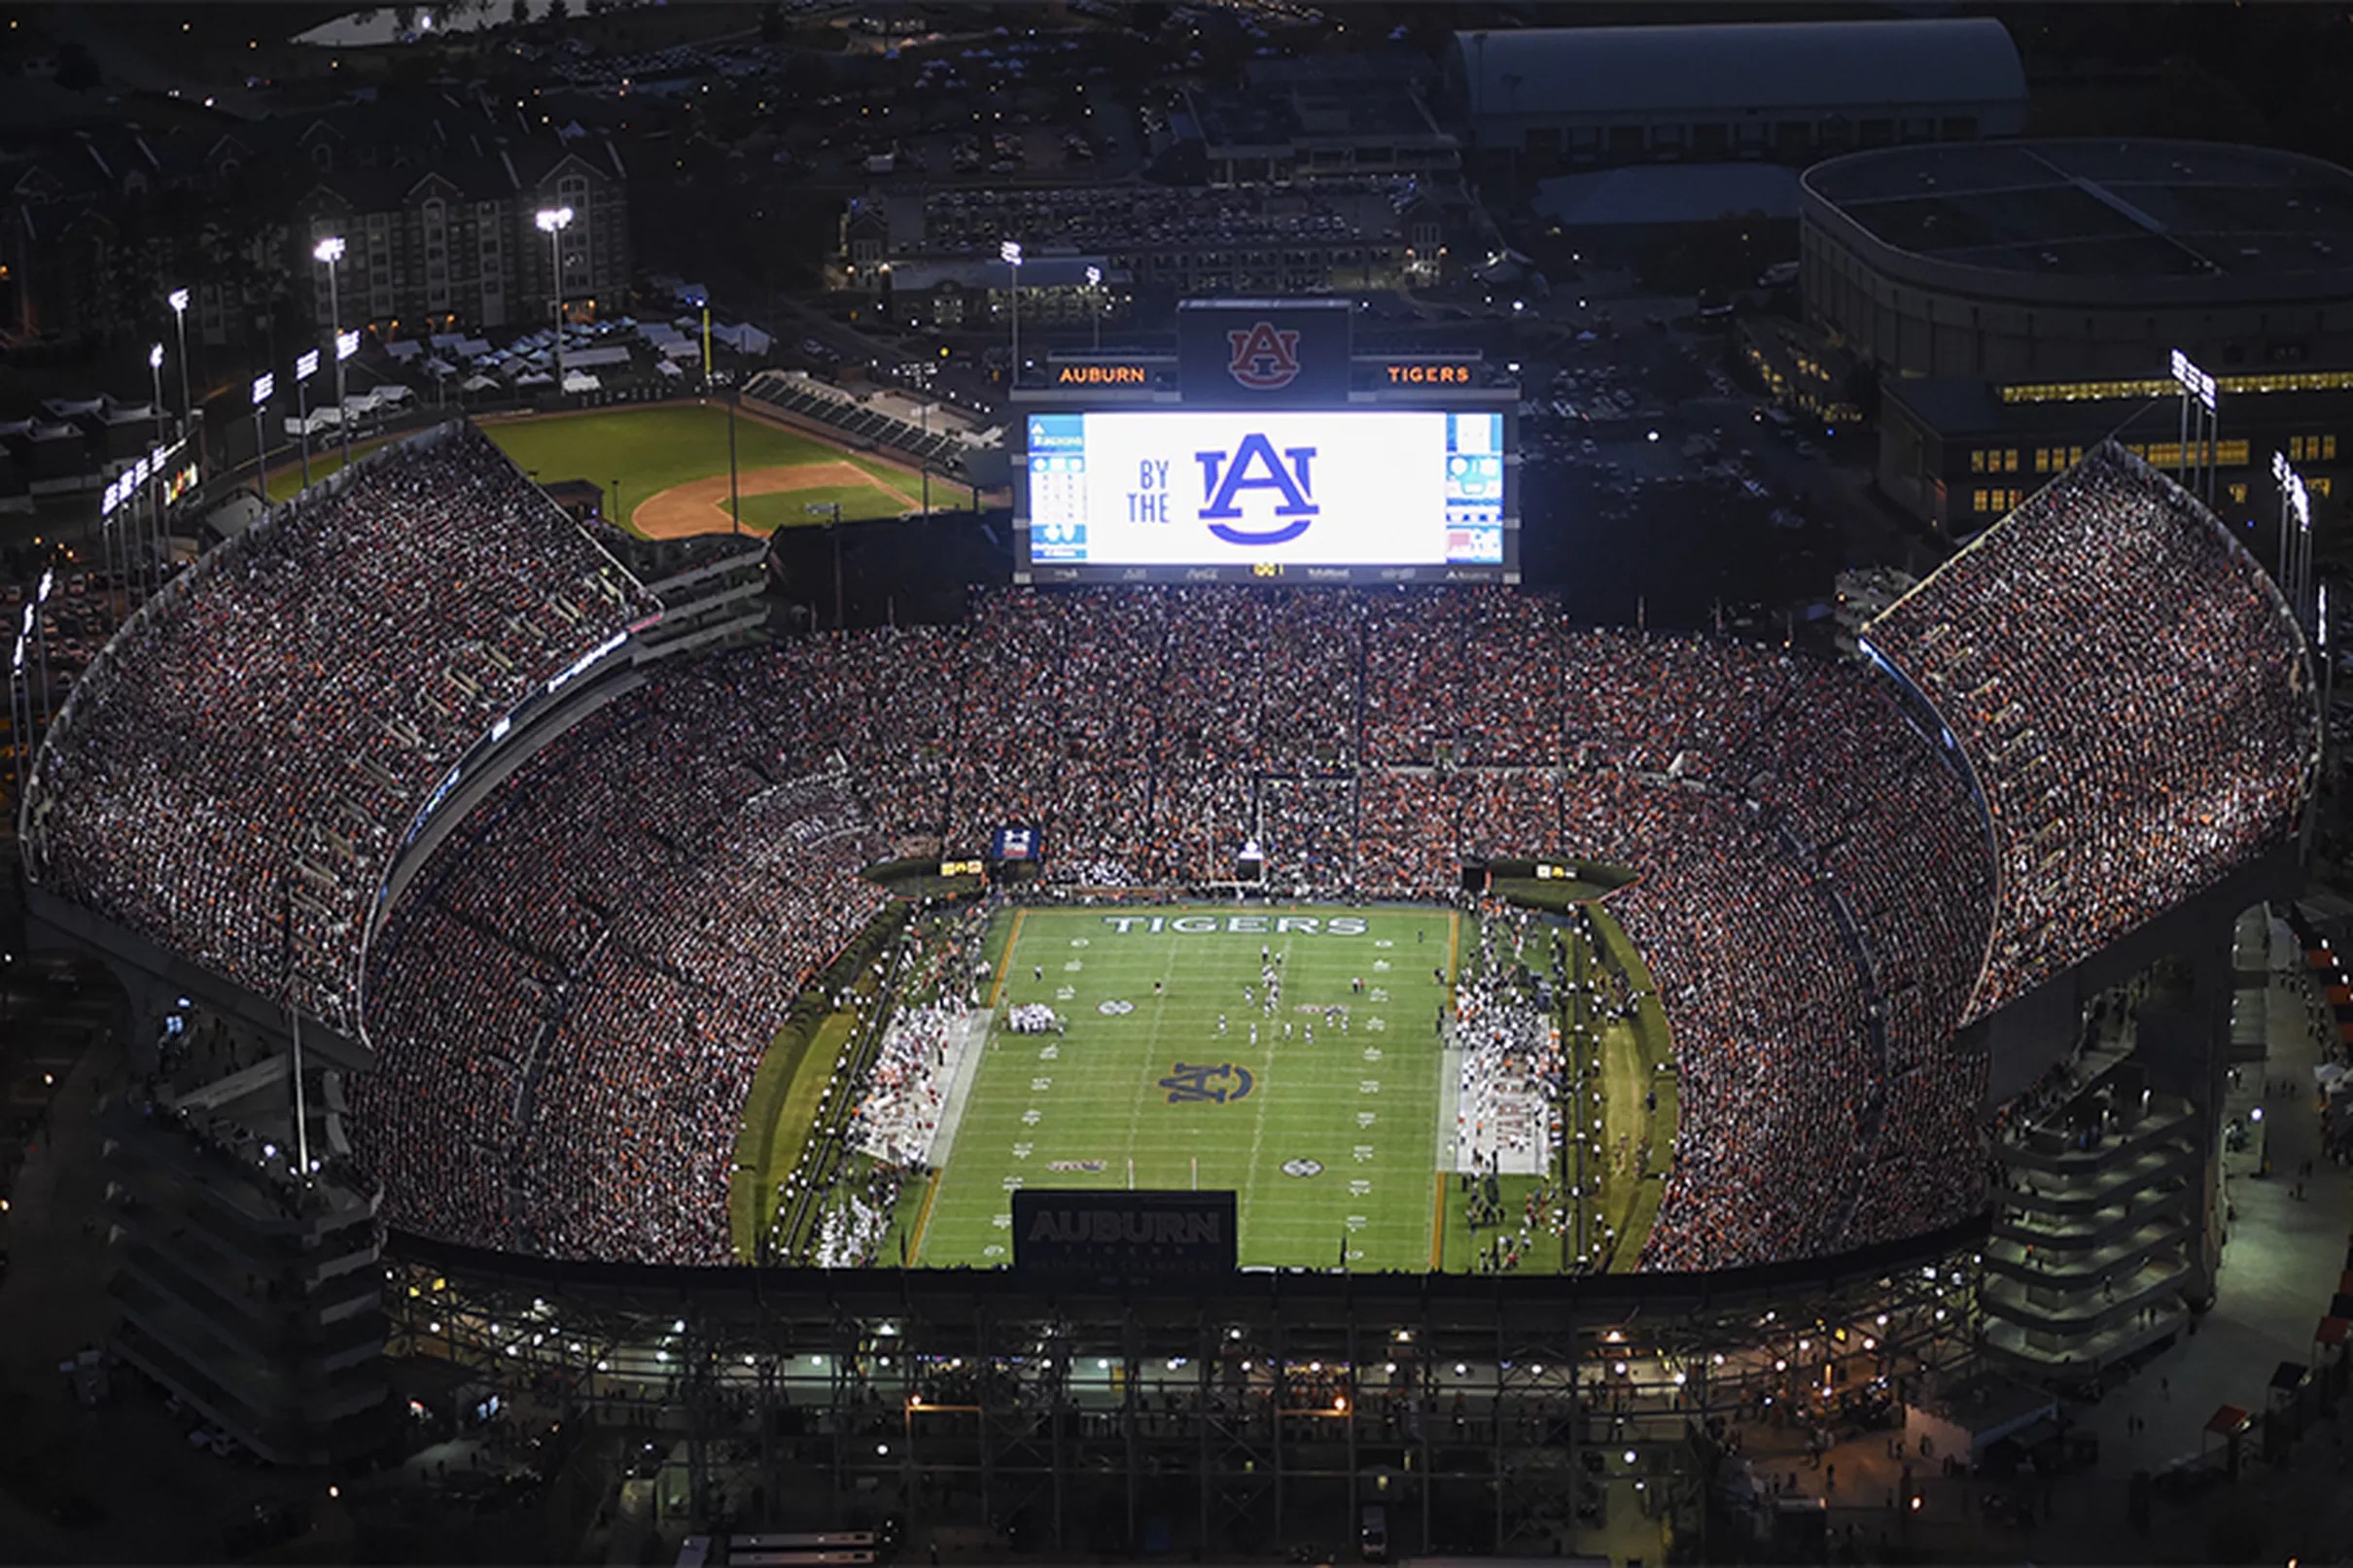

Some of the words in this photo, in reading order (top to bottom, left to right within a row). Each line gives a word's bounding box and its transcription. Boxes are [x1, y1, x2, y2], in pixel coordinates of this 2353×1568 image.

[1059, 366, 1145, 383] AUBURN
[1387, 366, 1469, 383] TIGERS
[1140, 459, 1170, 490] BY
[1127, 493, 1170, 523] THE
[1102, 917, 1367, 935] TIGERS
[1027, 1210, 1220, 1243] AUBURN
